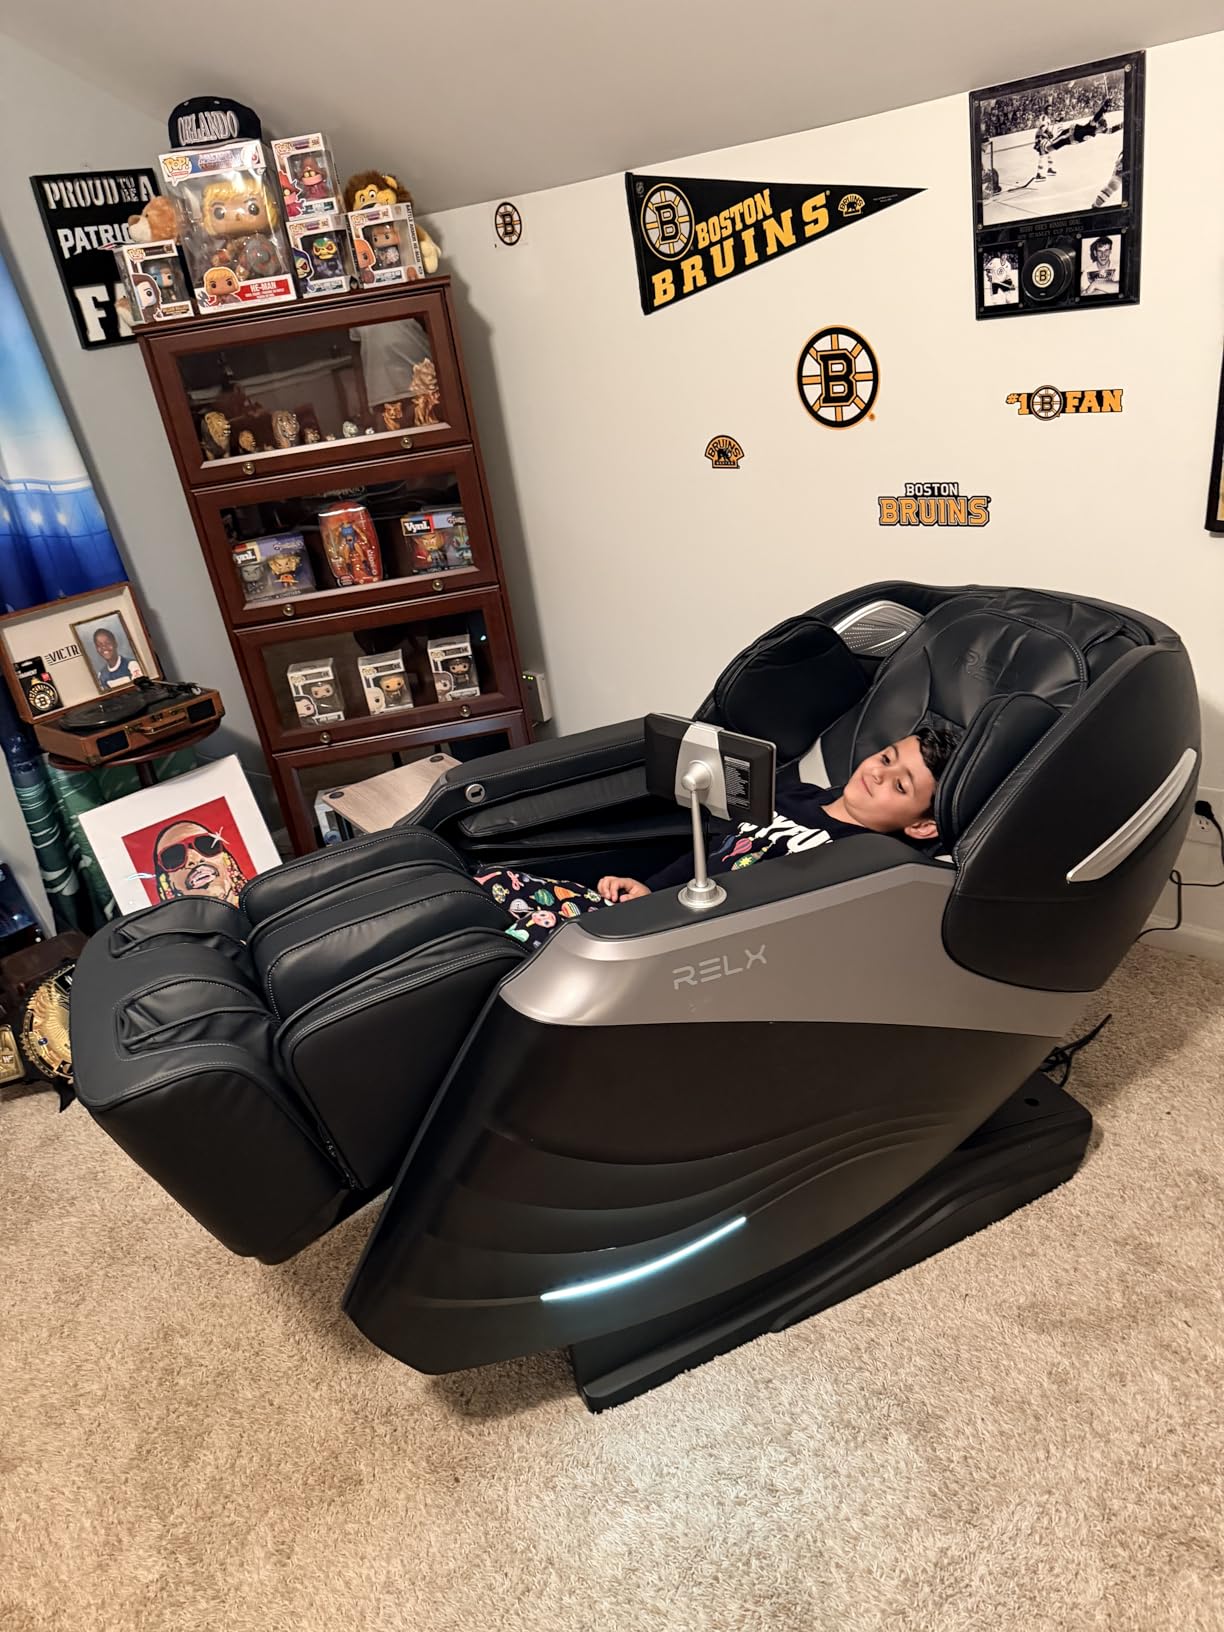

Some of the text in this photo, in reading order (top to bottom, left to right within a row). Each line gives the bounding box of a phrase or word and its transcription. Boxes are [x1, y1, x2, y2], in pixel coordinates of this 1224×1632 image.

[178, 110, 239, 146] ORLANDO
[163, 156, 189, 172] POP!
[42, 175, 154, 209] PROUD TO BE A
[654, 201, 680, 244] B
[695, 188, 773, 250] BOSTON
[652, 191, 830, 307] BRUINS
[250, 281, 277, 293] HE-MAN
[1039, 270, 1048, 281] B
[817, 350, 857, 406] B
[1006, 392, 1029, 415] #1
[1064, 389, 1123, 413] FAN
[707, 438, 741, 457] BRUINS
[906, 483, 958, 496] BOSTON
[879, 496, 990, 526] BRUINS
[672, 944, 767, 990] RELX
